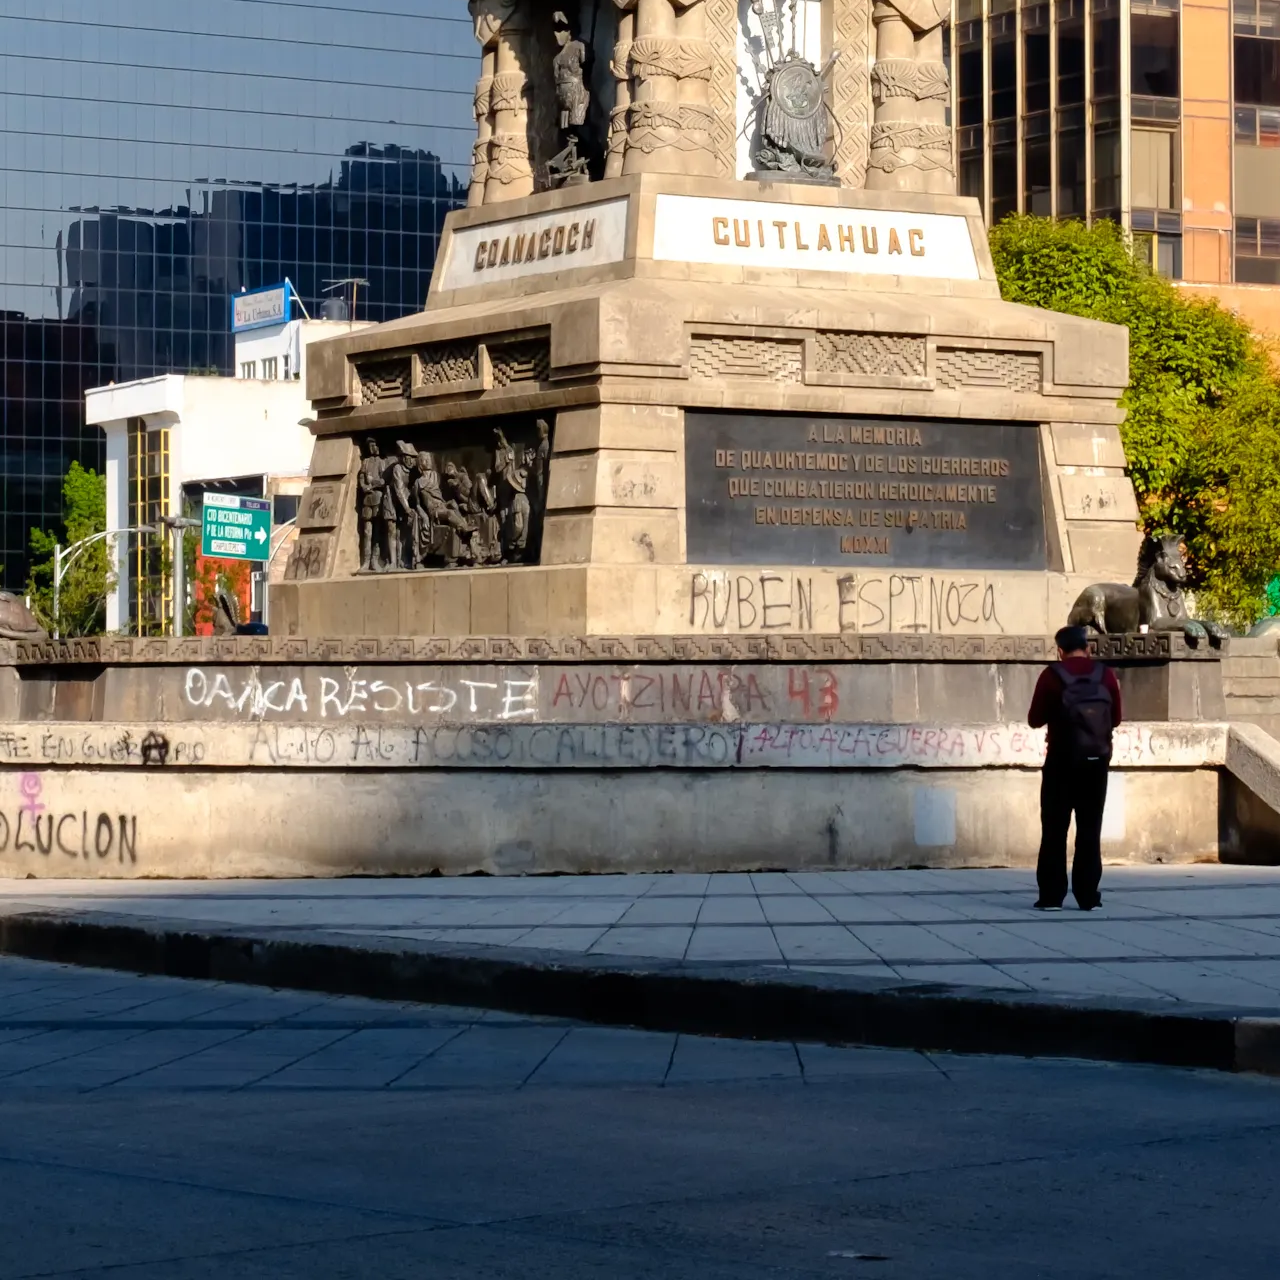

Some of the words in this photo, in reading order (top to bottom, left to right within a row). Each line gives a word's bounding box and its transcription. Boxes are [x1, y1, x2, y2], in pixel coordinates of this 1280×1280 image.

[474, 219, 596, 272] COANACOCH
[712, 216, 926, 257] CUITLAHUAC
[807, 424, 818, 443] A
[823, 425, 844, 444] LA
[850, 426, 922, 446] MEMORIA
[715, 449, 735, 468] DE
[741, 450, 848, 472] QUAUHTEMOC
[851, 454, 861, 471] Y
[865, 455, 884, 473] DE
[887, 456, 917, 475] LOS
[921, 457, 1010, 478] GUERREROS
[728, 477, 760, 499] QUE
[764, 479, 873, 501] COMBATIERON
[878, 483, 997, 504] HEROICAMENTE
[211, 524, 217, 537] DE
[217, 525, 224, 538] LA
[224, 526, 244, 540] REFORMA
[218, 510, 253, 526] BICENTENARIO
[755, 506, 775, 526] EN
[780, 507, 854, 527] DEFENSA
[859, 508, 878, 528] DE
[884, 509, 904, 528] SU
[906, 510, 966, 530] PATRIA
[689, 573, 814, 629] RUBEN
[319, 675, 540, 719] RESISTE
[552, 670, 771, 714] AYOTZINAPA
[787, 667, 840, 720] 43
